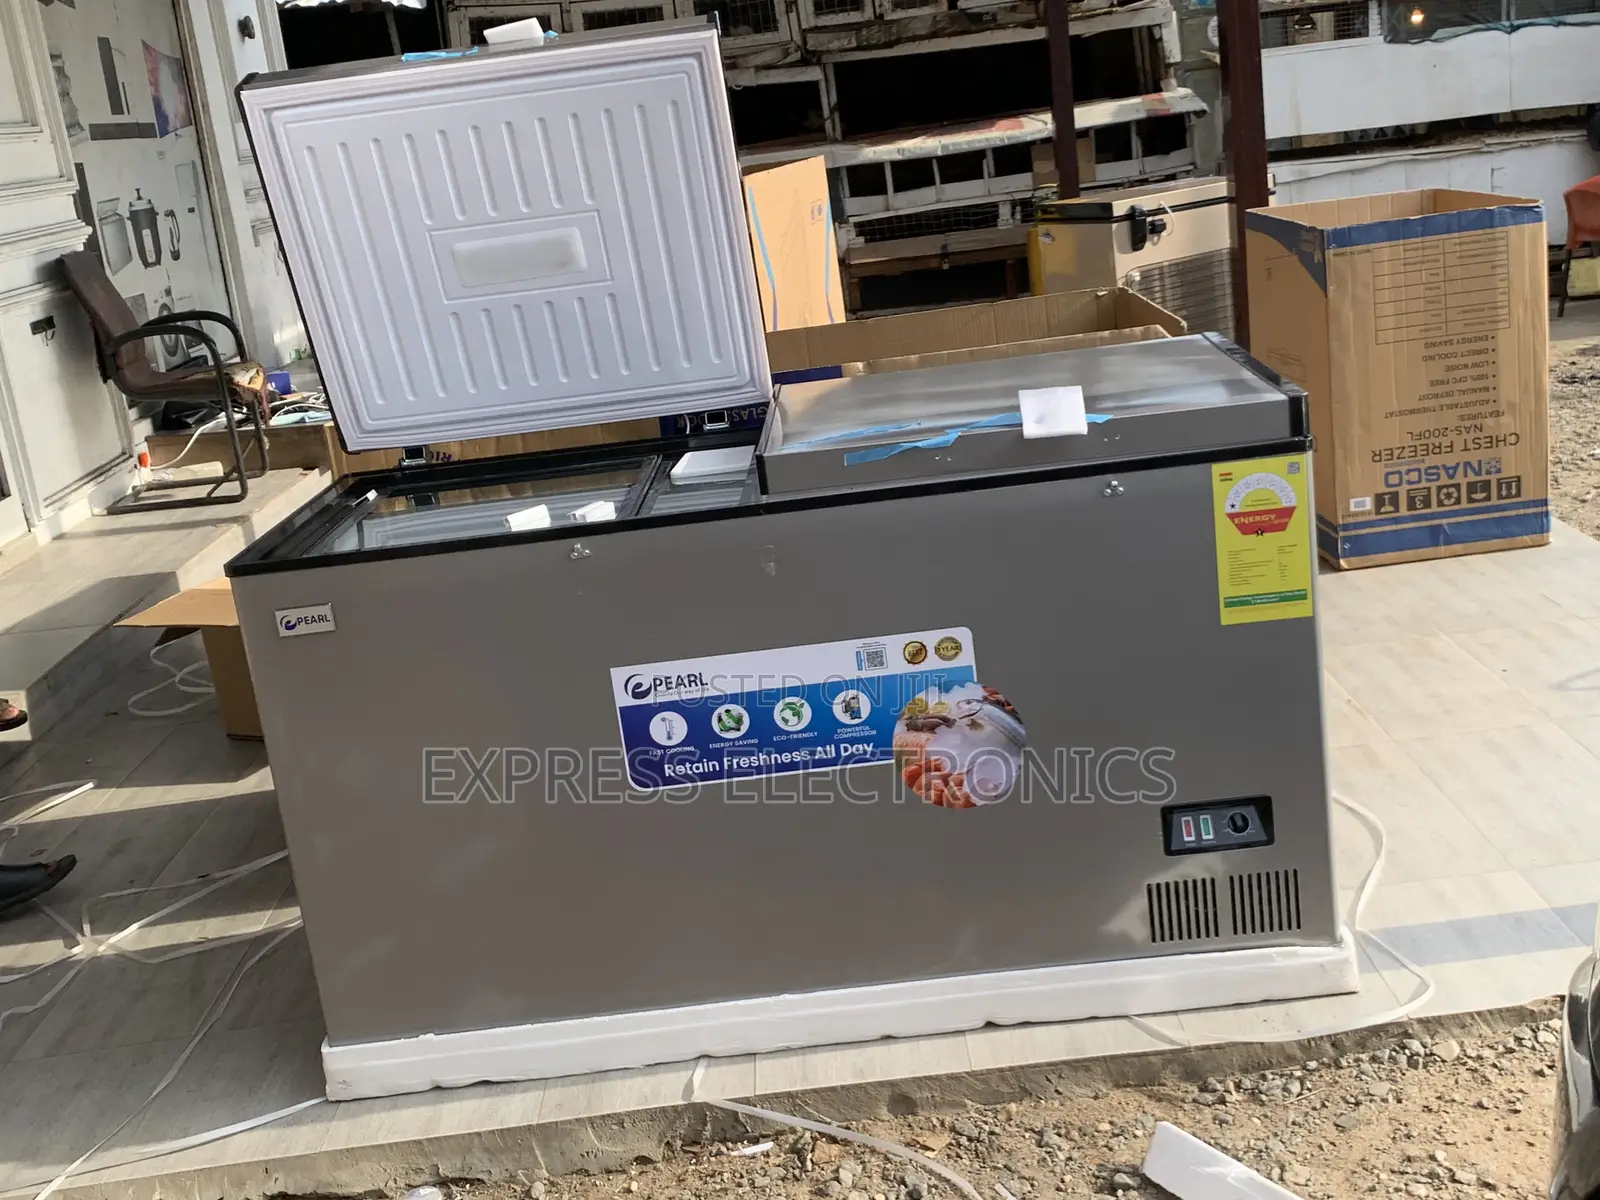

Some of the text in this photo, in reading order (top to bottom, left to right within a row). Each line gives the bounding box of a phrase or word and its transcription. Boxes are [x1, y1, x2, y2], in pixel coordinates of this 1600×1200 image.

[1424, 335, 1489, 349] ENERGY SAVING
[1422, 347, 1489, 362] DIRECT COOLING
[1444, 360, 1489, 372] LOW NOISE
[1429, 378, 1450, 387] FREE
[1451, 375, 1468, 384] CFC
[1418, 386, 1490, 401] MANUAL DEFROST
[1384, 399, 1490, 419] ADJUSTABLE THERMOSTAT
[1456, 410, 1505, 422] FEATURES:
[1406, 423, 1483, 441] NAS-200FL
[1371, 432, 1520, 463] CHEST FREEZER
[1384, 459, 1482, 488] NASCO
[1414, 496, 1425, 508] 3
[1233, 513, 1277, 526] ENERGY
[296, 613, 331, 626] PEARL
[653, 672, 709, 692] PEARL
[834, 730, 877, 740] COMPRESSOR
[837, 725, 871, 734] POWERFUL
[773, 731, 819, 742] ECO-FRIENDLY
[709, 738, 759, 749] ENERGY SAVING
[649, 748, 665, 756] FAST
[664, 742, 874, 777] Retain Freshness All Day
